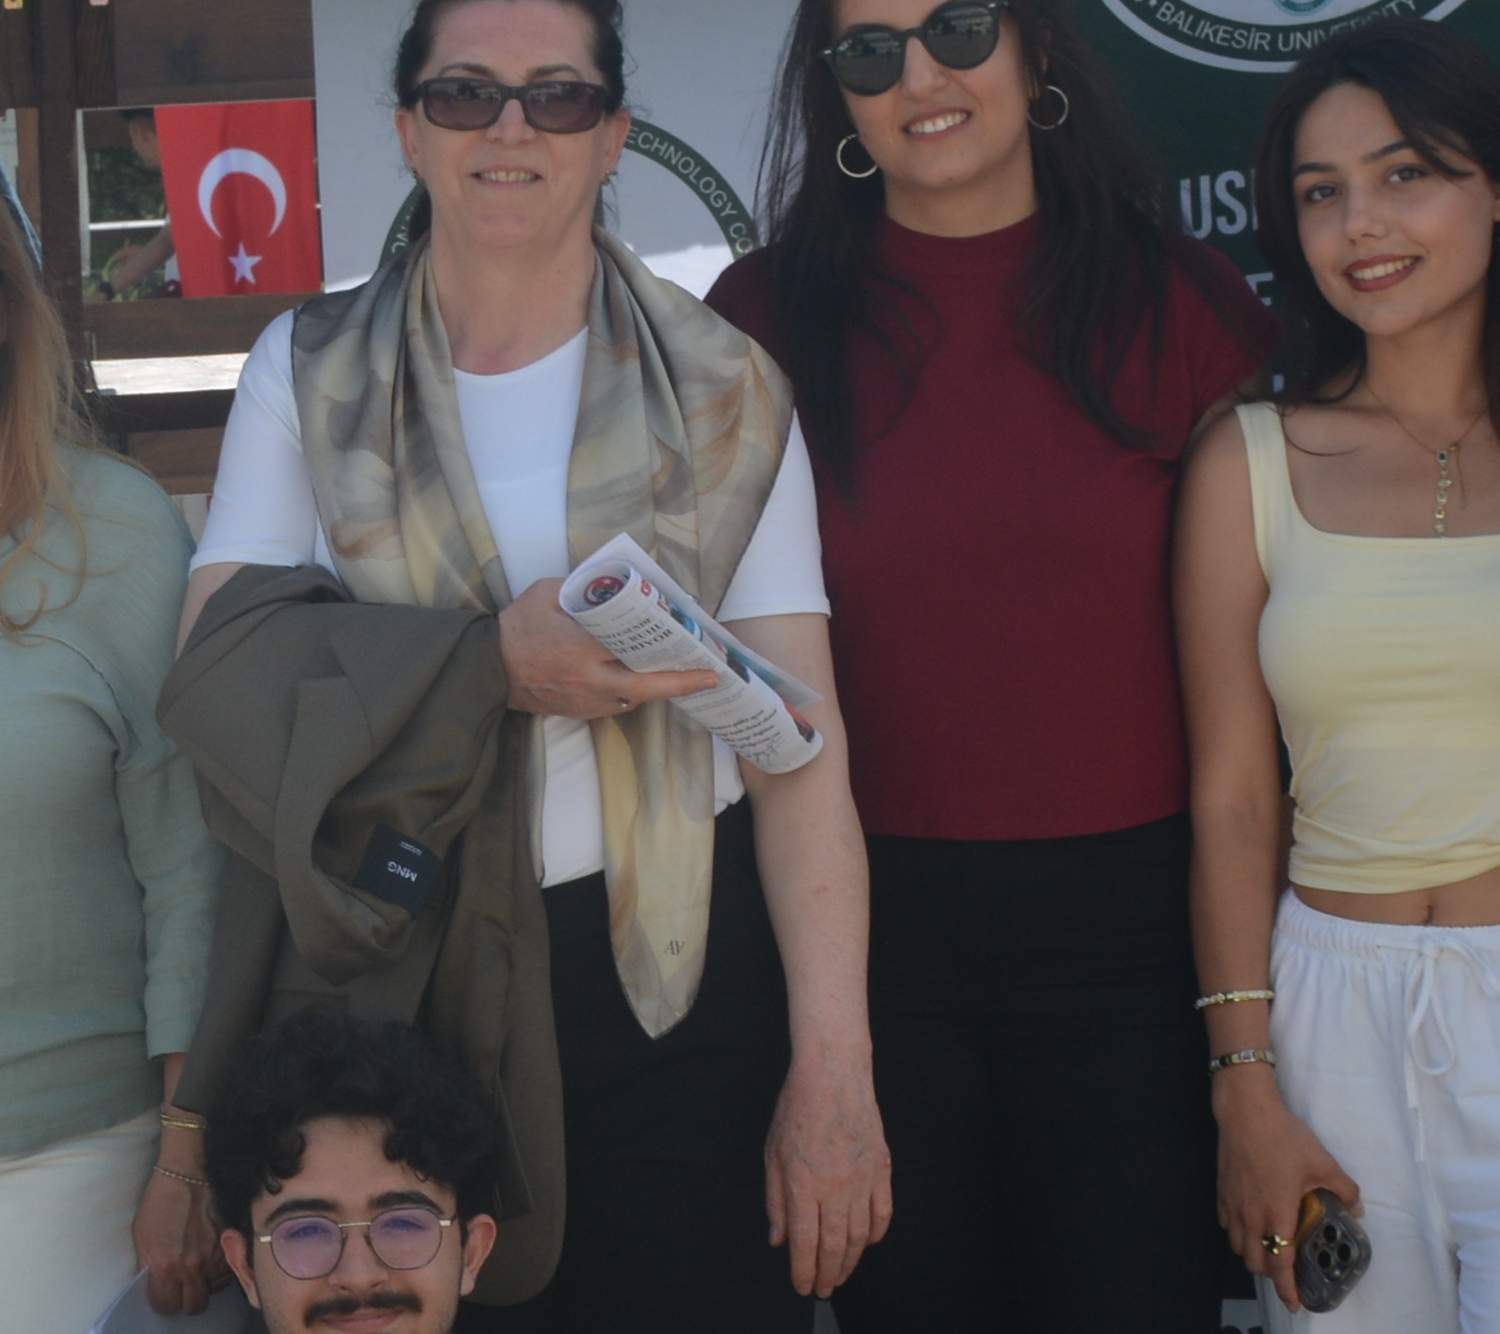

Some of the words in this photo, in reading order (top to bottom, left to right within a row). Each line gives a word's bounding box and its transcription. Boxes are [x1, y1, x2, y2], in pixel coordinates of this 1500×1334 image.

[1155, 0, 1272, 52] BALIKESİR
[623, 126, 738, 218] ECHNOLOGY
[387, 860, 418, 883] MNG
